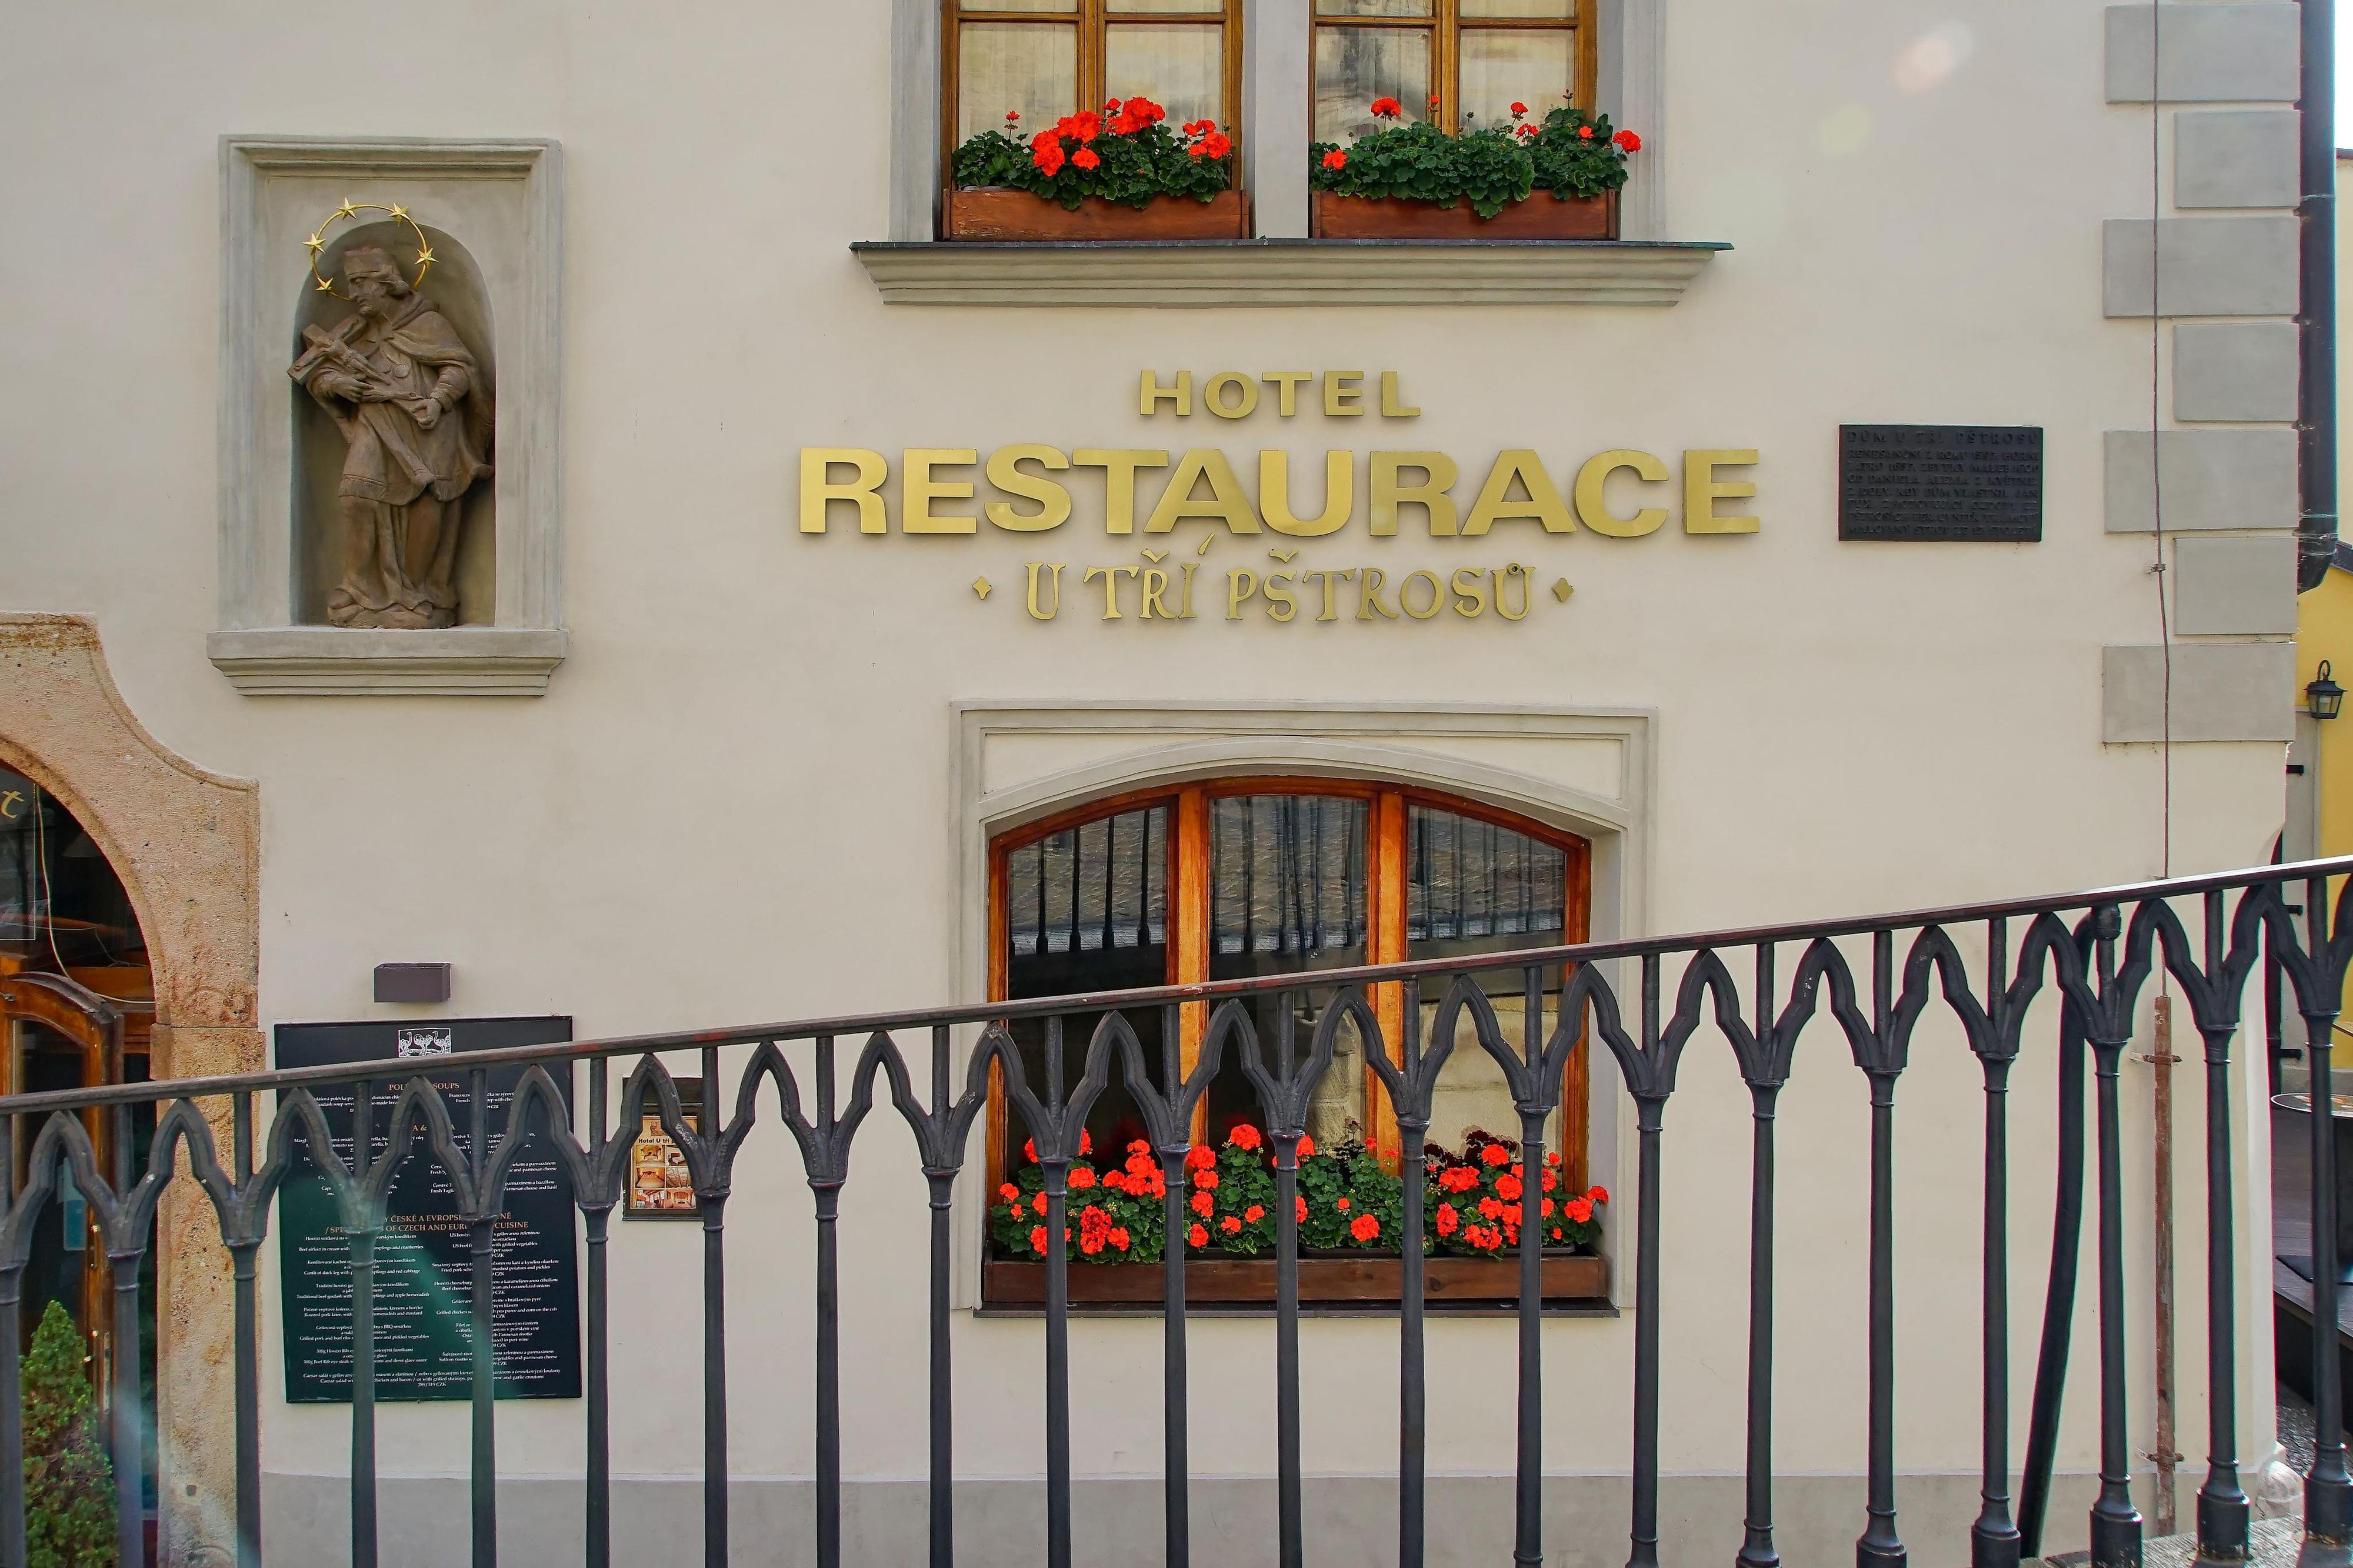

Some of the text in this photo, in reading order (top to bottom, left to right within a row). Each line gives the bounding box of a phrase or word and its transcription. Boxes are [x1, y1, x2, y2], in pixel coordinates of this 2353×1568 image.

[1140, 370, 1421, 418] HOTEL
[799, 443, 1759, 537] RESTAURACE
[1025, 532, 1535, 622] U TŘÍ PŠTROSŮ
[391, 1213, 416, 1222] ČESKÉ
